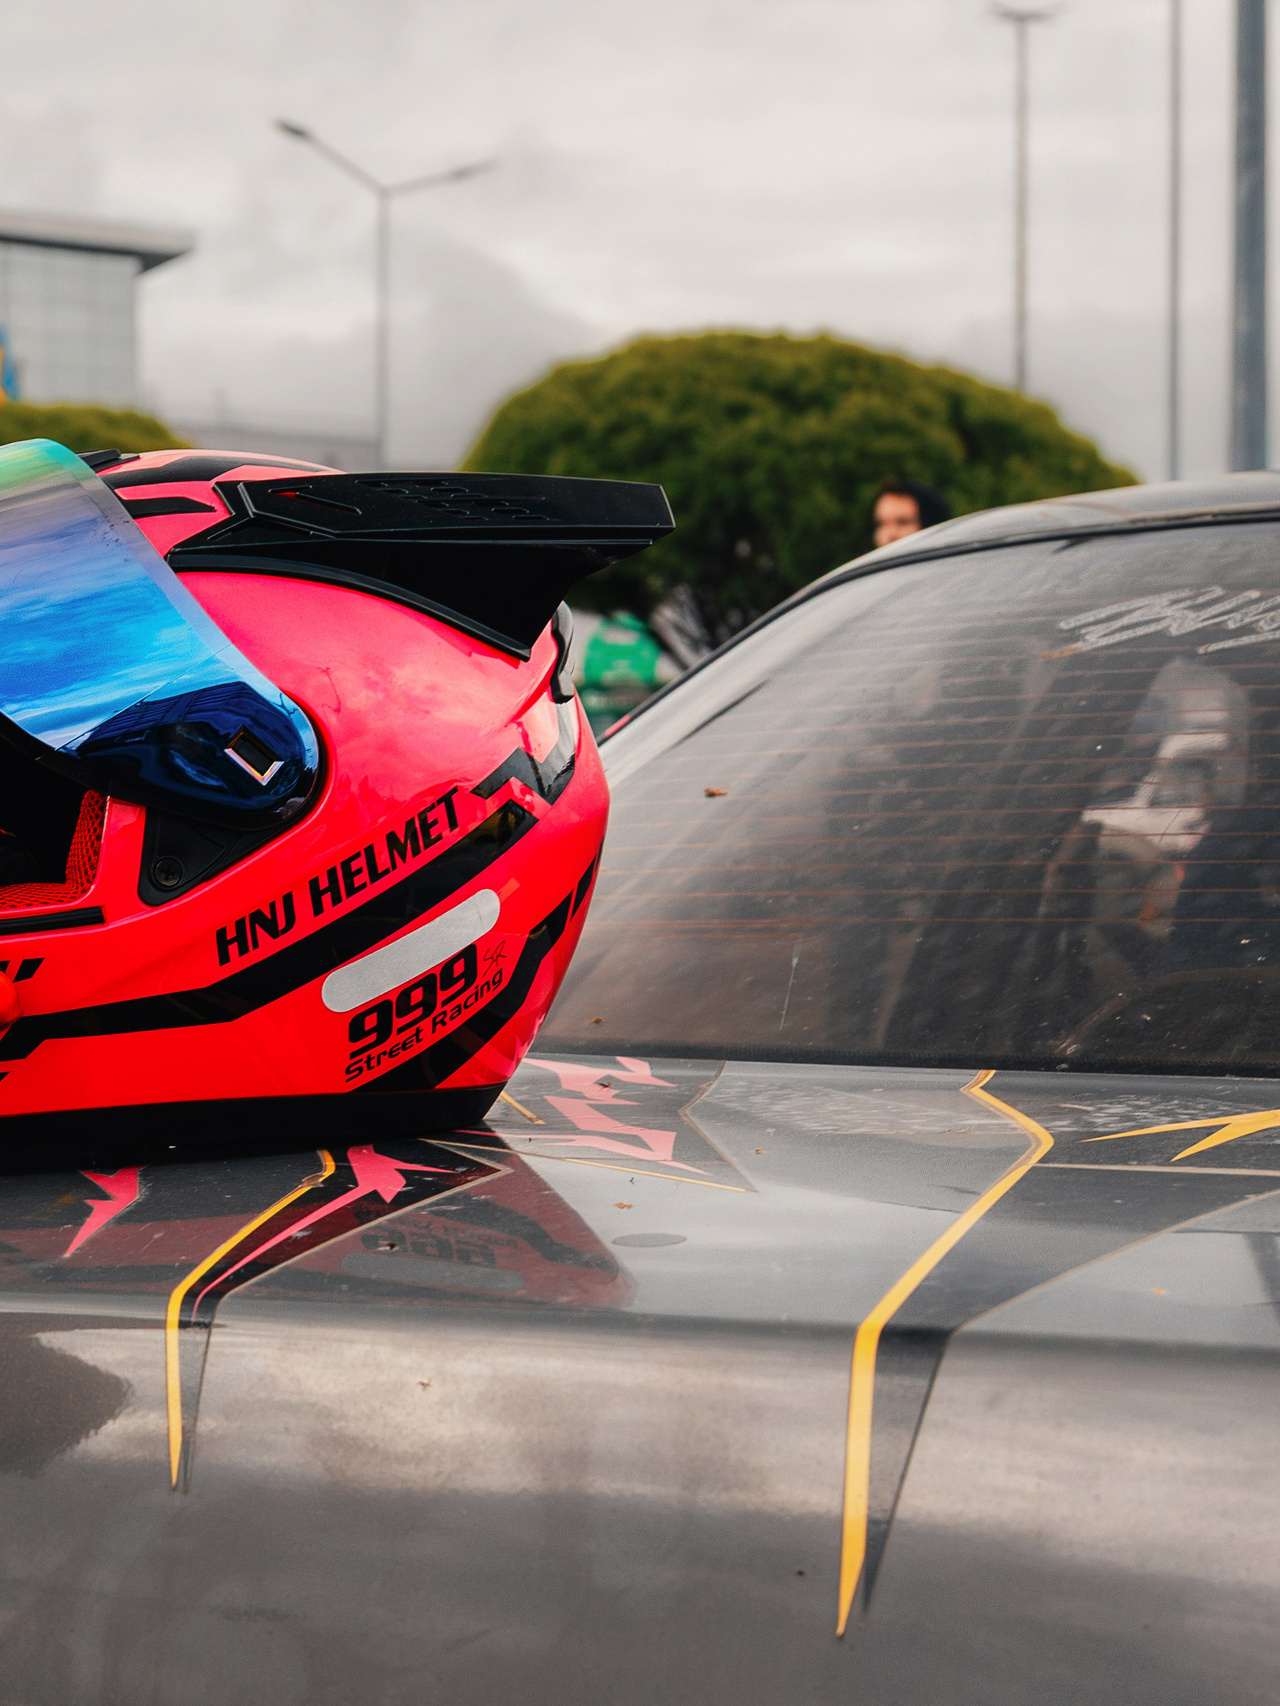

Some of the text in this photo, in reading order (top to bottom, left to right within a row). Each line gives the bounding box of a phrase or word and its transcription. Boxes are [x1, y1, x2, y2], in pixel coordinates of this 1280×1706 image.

[215, 787, 459, 967] HNJ HELMET
[344, 968, 503, 1083] Street Racing
[349, 943, 478, 1059] 999
